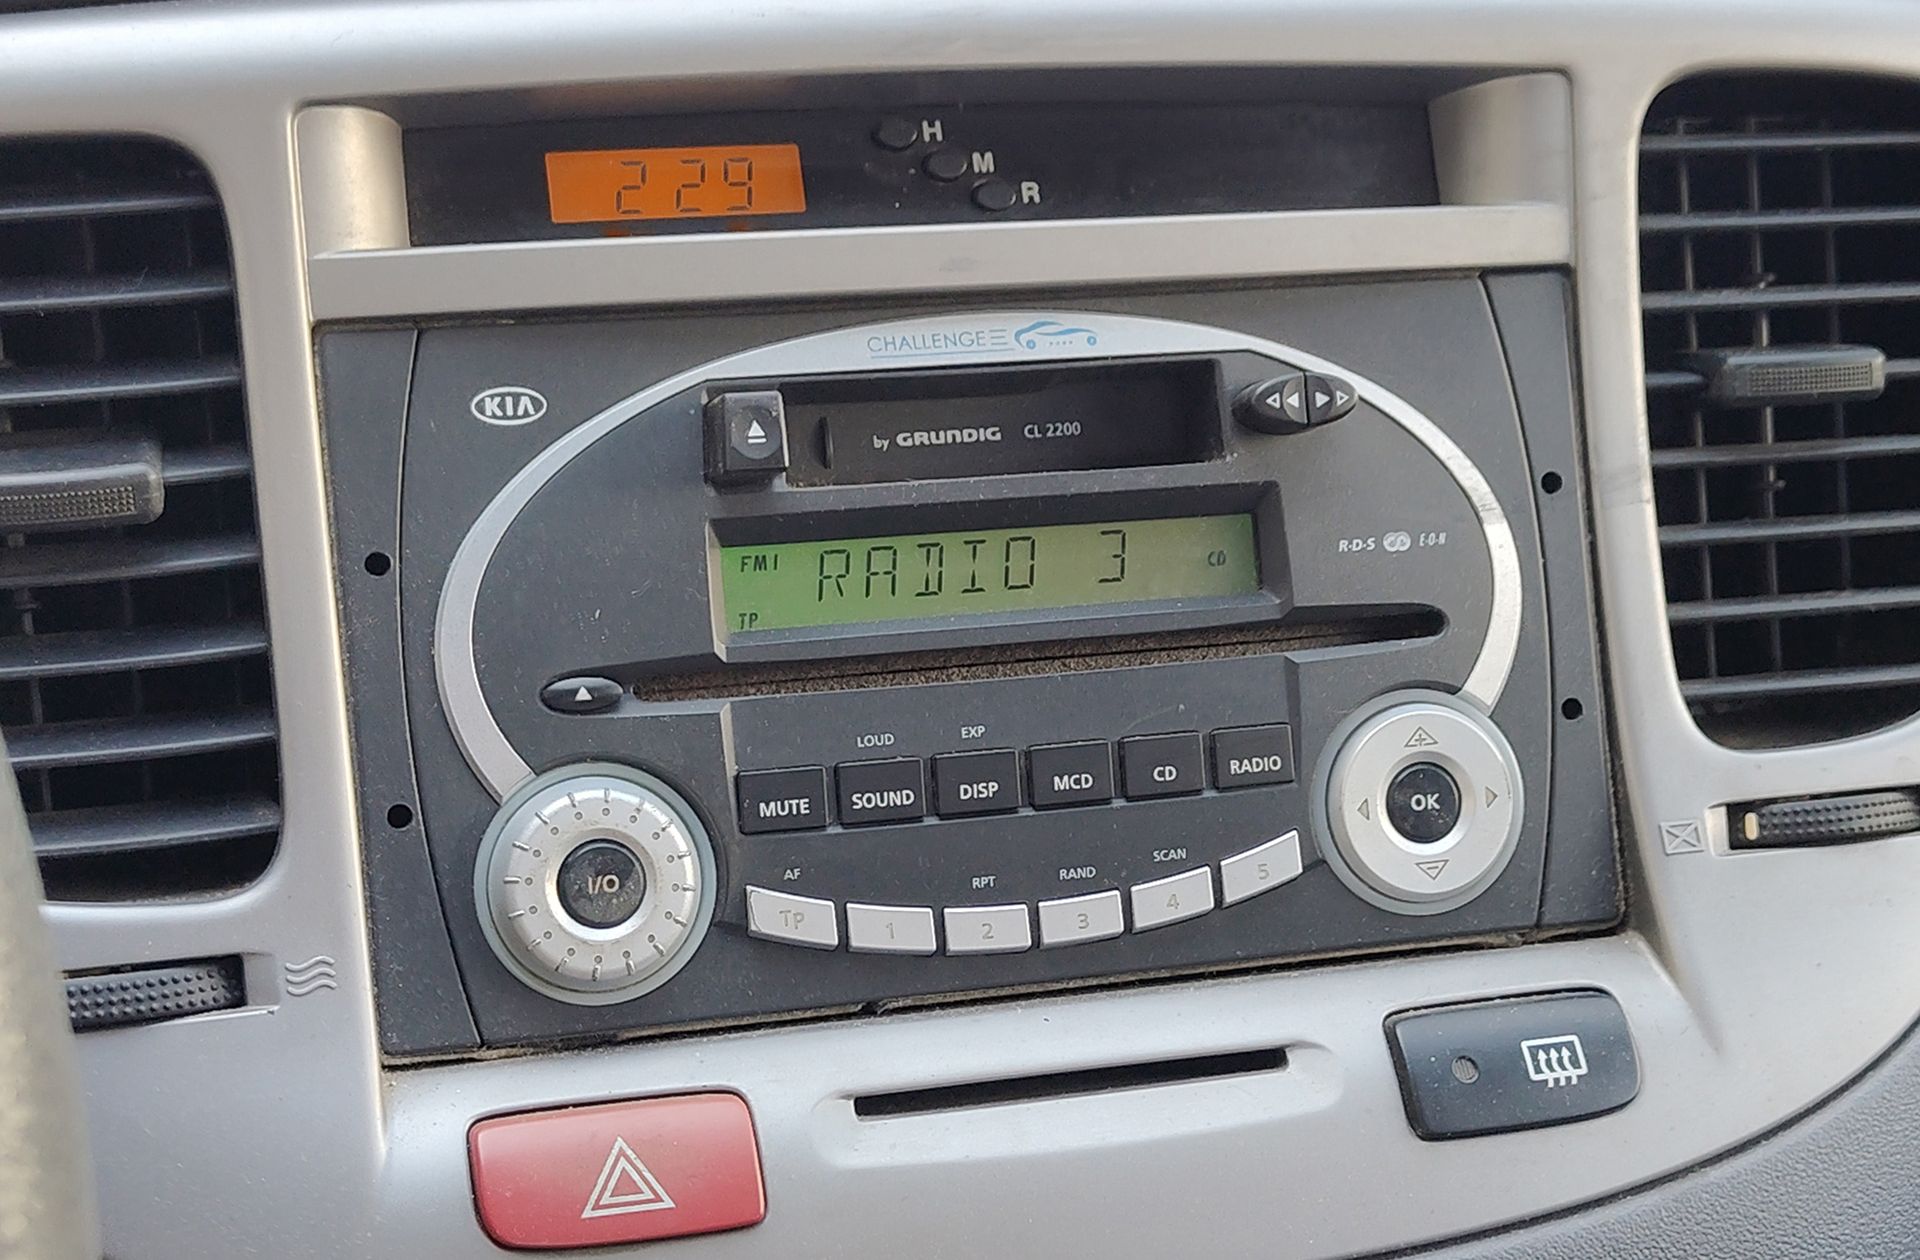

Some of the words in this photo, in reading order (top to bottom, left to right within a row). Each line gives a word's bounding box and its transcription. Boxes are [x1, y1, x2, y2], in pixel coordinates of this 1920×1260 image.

[922, 120, 943, 142] H
[971, 152, 995, 174] M
[1020, 181, 1041, 204] R
[484, 395, 536, 417] KIA
[872, 434, 890, 451] by
[896, 426, 1002, 447] GRUNDIG
[1023, 424, 1042, 439] CL
[1046, 421, 1082, 437] 2200
[817, 534, 1037, 603] RADIO
[1098, 529, 1127, 583] 3
[1207, 550, 1227, 568] CD
[738, 612, 759, 630] TP
[857, 734, 895, 748] LOUD
[961, 725, 986, 739] EXP
[1153, 765, 1177, 783] CD
[1229, 755, 1282, 775] RADIO
[959, 782, 999, 800] DISP
[1053, 773, 1094, 792] MCD
[759, 798, 810, 818] MUTE
[851, 790, 915, 811] SOUND
[1410, 793, 1441, 812] OK
[1152, 848, 1187, 863] SCAN
[783, 867, 801, 881] AF
[1059, 866, 1097, 881] RAND
[1257, 863, 1270, 881] 5
[972, 876, 996, 890] RPT
[1166, 892, 1180, 911] 4
[779, 909, 805, 930] TP
[1077, 912, 1090, 930] 3
[885, 922, 895, 940] 1
[981, 922, 994, 940] 2
